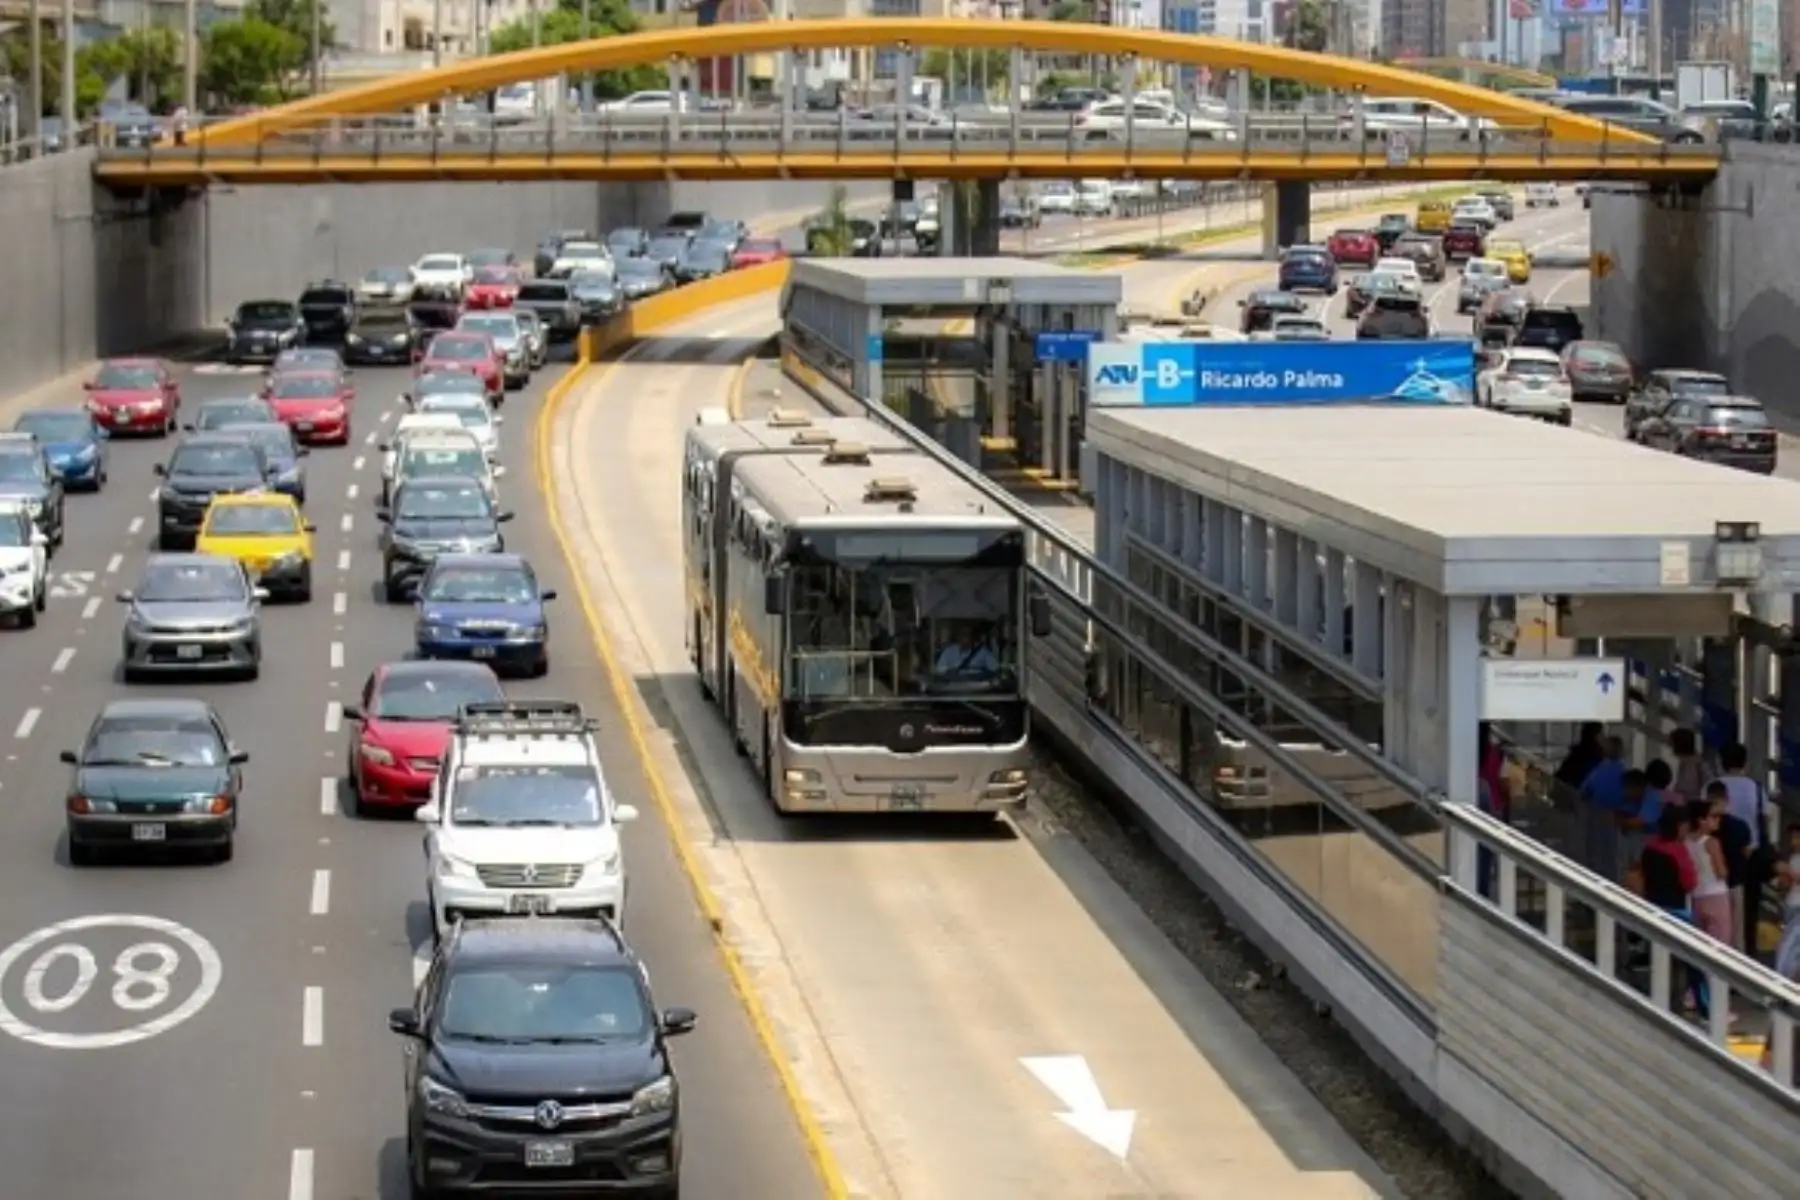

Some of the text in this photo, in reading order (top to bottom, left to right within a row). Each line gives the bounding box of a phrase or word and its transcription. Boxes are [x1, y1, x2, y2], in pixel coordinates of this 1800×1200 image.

[1157, 358, 1181, 390] B
[1201, 369, 1344, 390] Ricardo Palma
